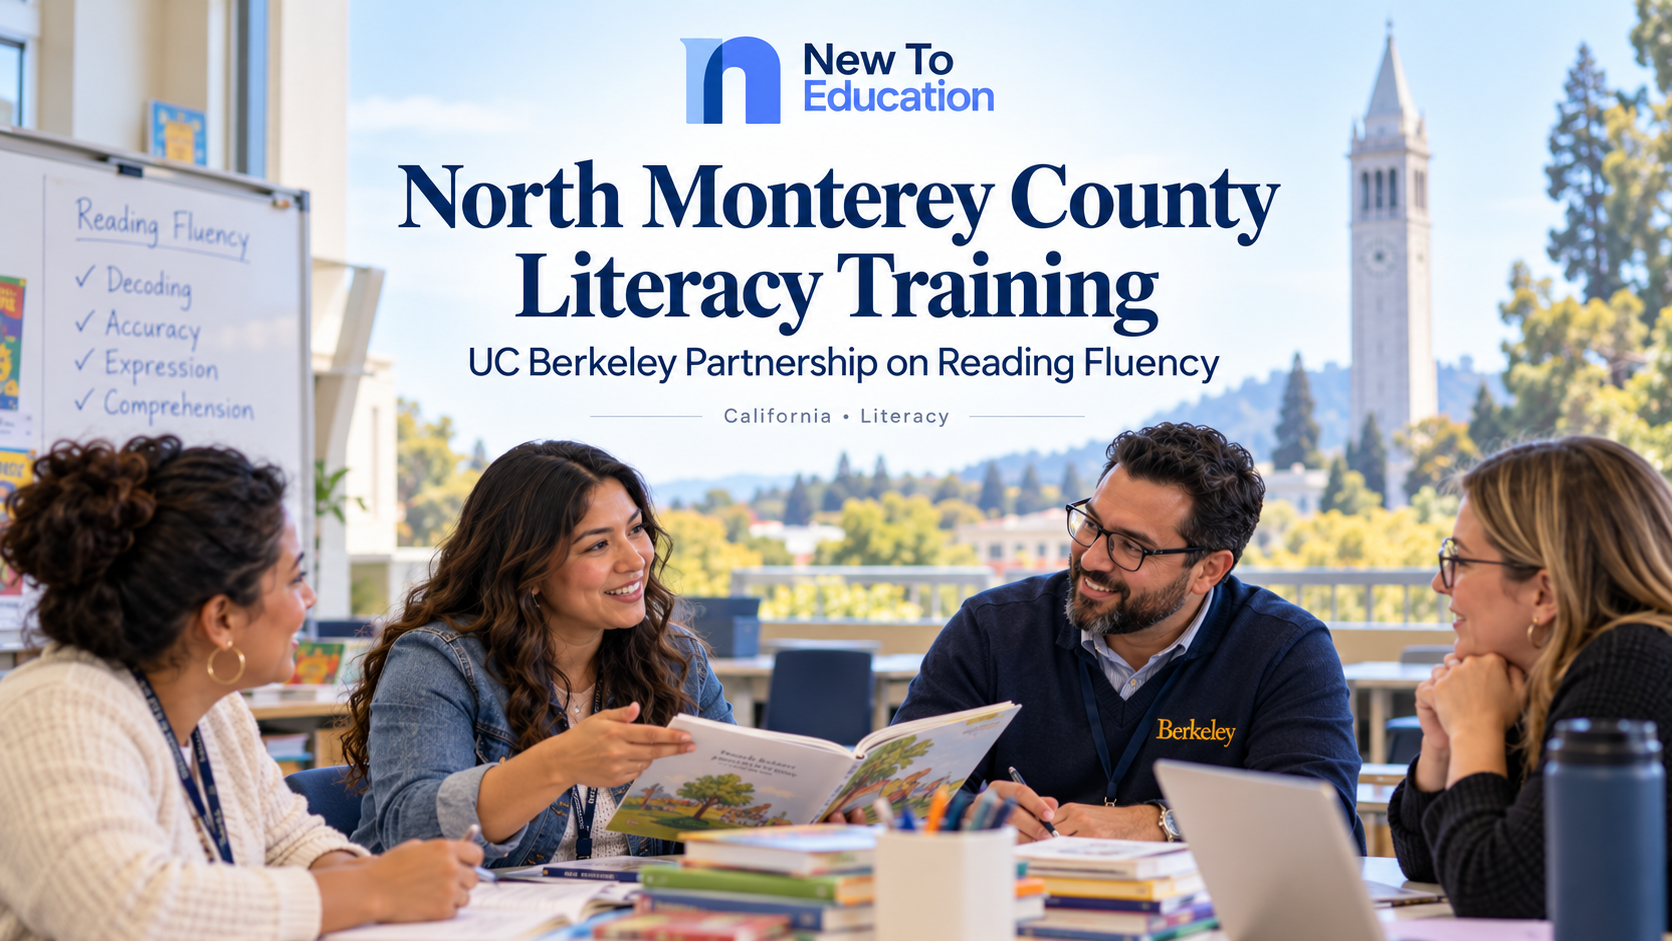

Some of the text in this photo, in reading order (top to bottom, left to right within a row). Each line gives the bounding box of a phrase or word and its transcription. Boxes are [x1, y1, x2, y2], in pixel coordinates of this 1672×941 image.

[75, 197, 250, 260] Reading Fluency
[107, 265, 192, 311] Decoding
[105, 309, 200, 351] Accuracy
[105, 348, 219, 385] Expression
[103, 388, 255, 426] Comprehension
[1156, 718, 1236, 748] Berkeley
